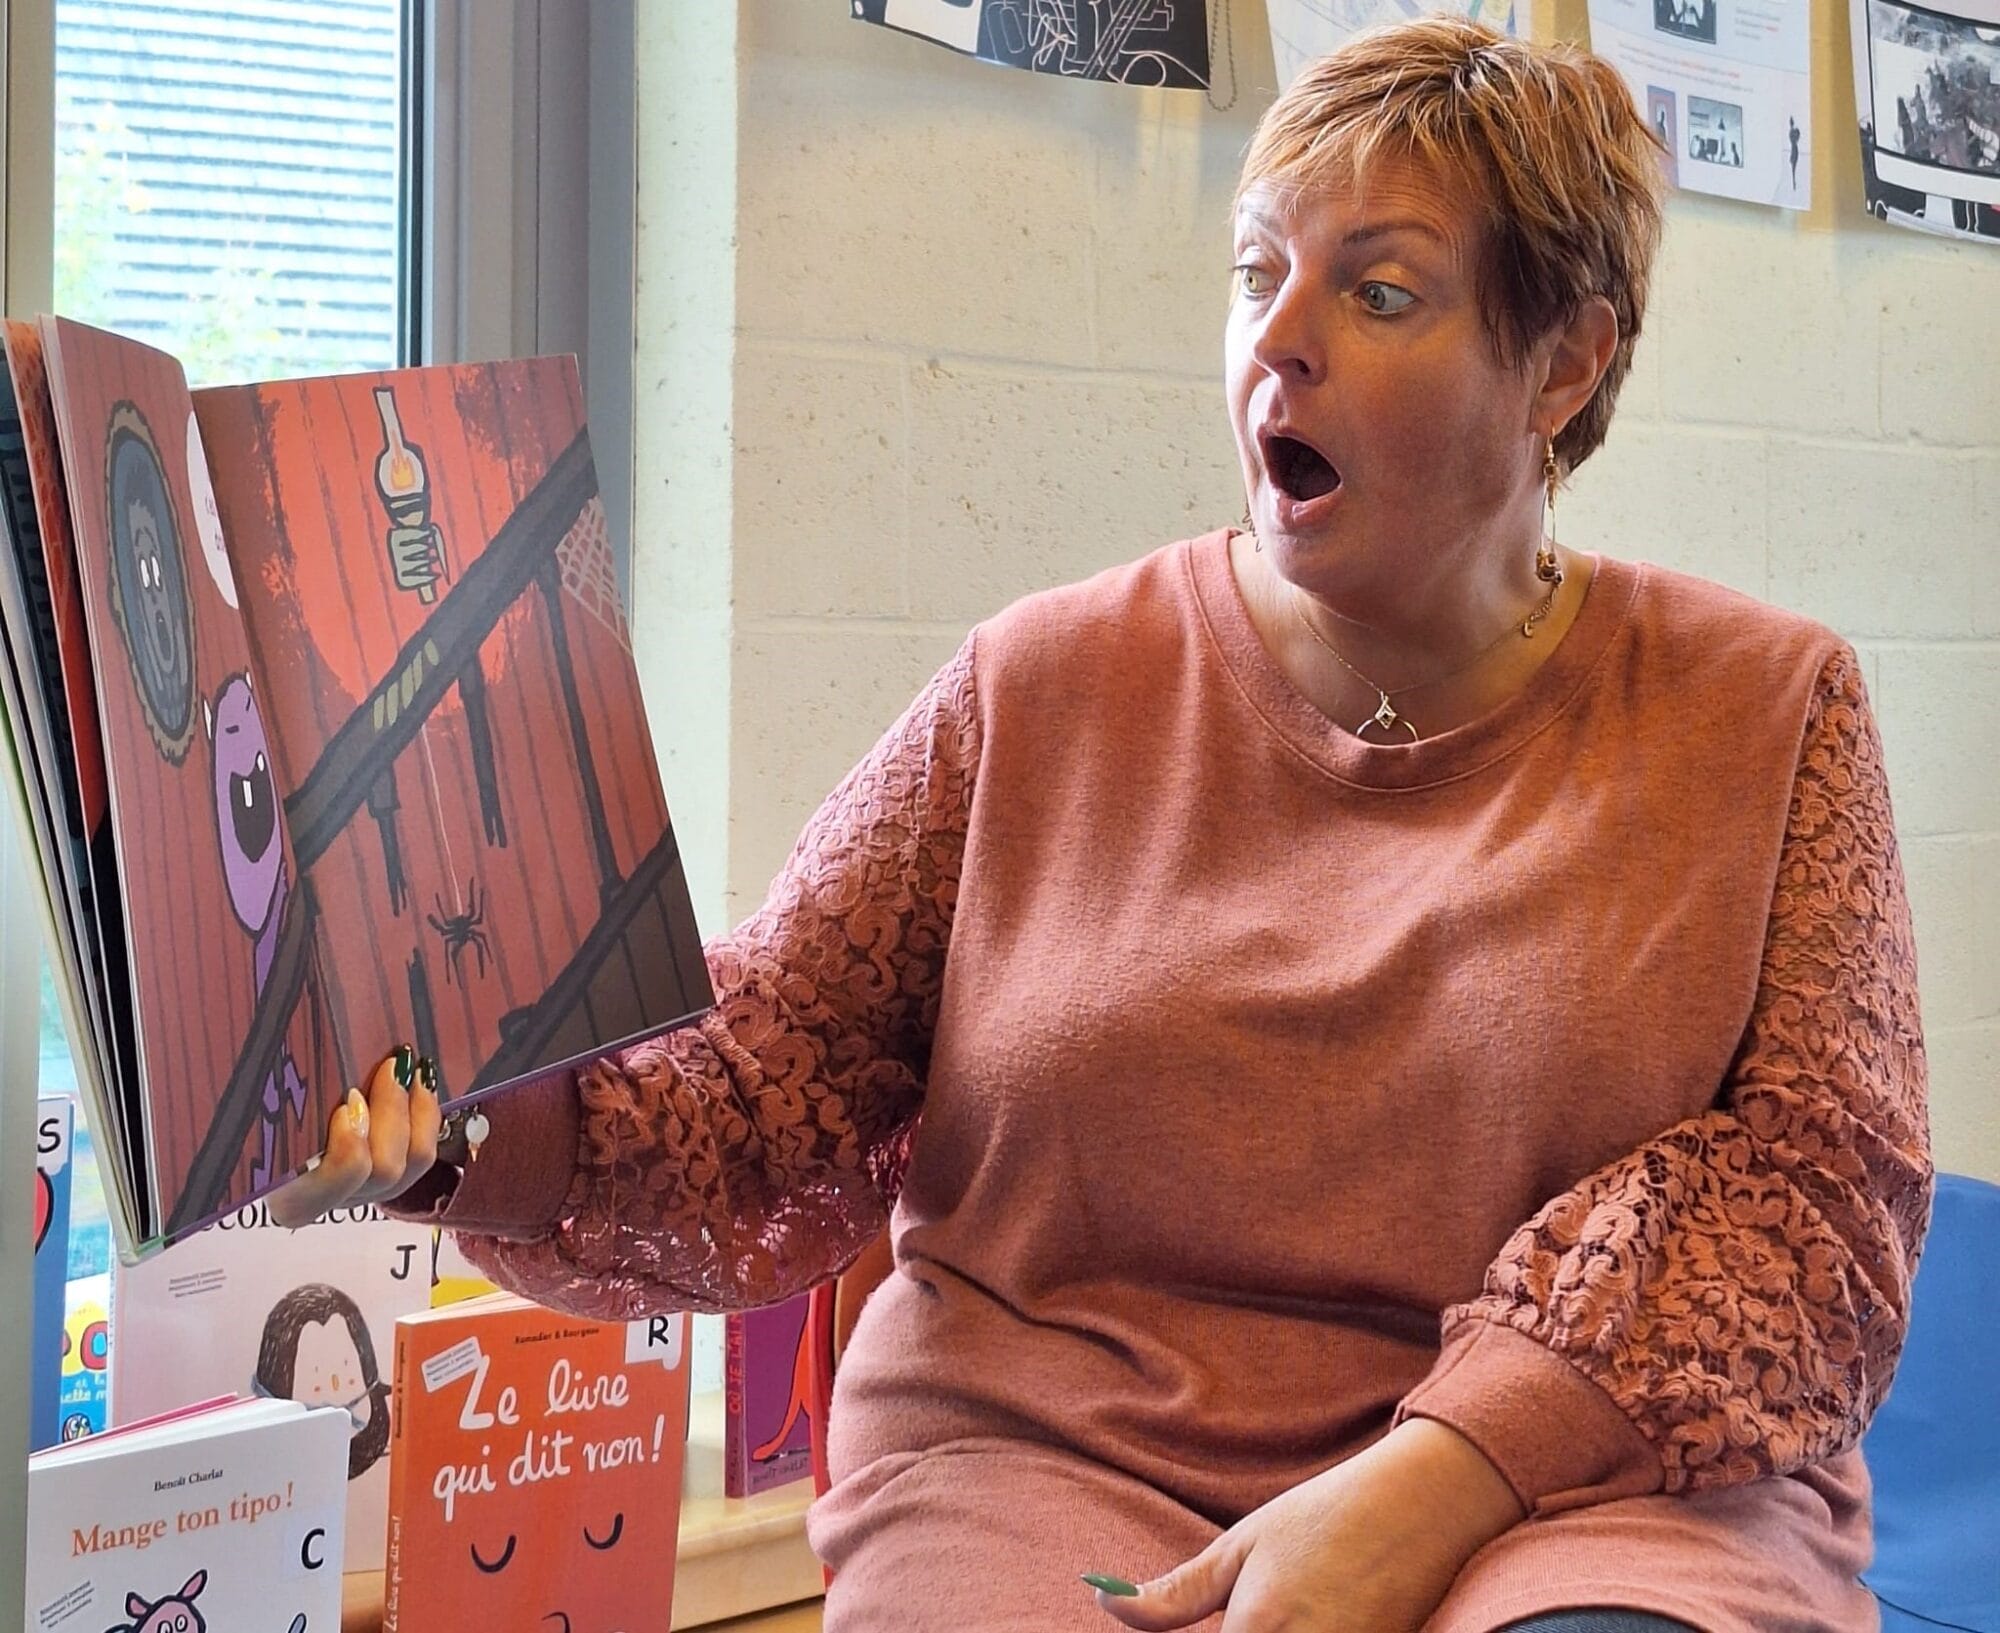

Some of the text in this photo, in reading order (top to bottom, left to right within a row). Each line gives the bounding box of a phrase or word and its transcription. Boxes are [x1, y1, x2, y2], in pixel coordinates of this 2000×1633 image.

[37, 1118, 61, 1153] S
[390, 1244, 417, 1280] J
[648, 1316, 669, 1347] R
[544, 1359, 629, 1416] livre
[433, 1445, 496, 1522] qui
[508, 1430, 574, 1486] dit
[71, 1518, 168, 1557] Mange
[176, 1507, 220, 1533] ton
[301, 1528, 325, 1570] C
